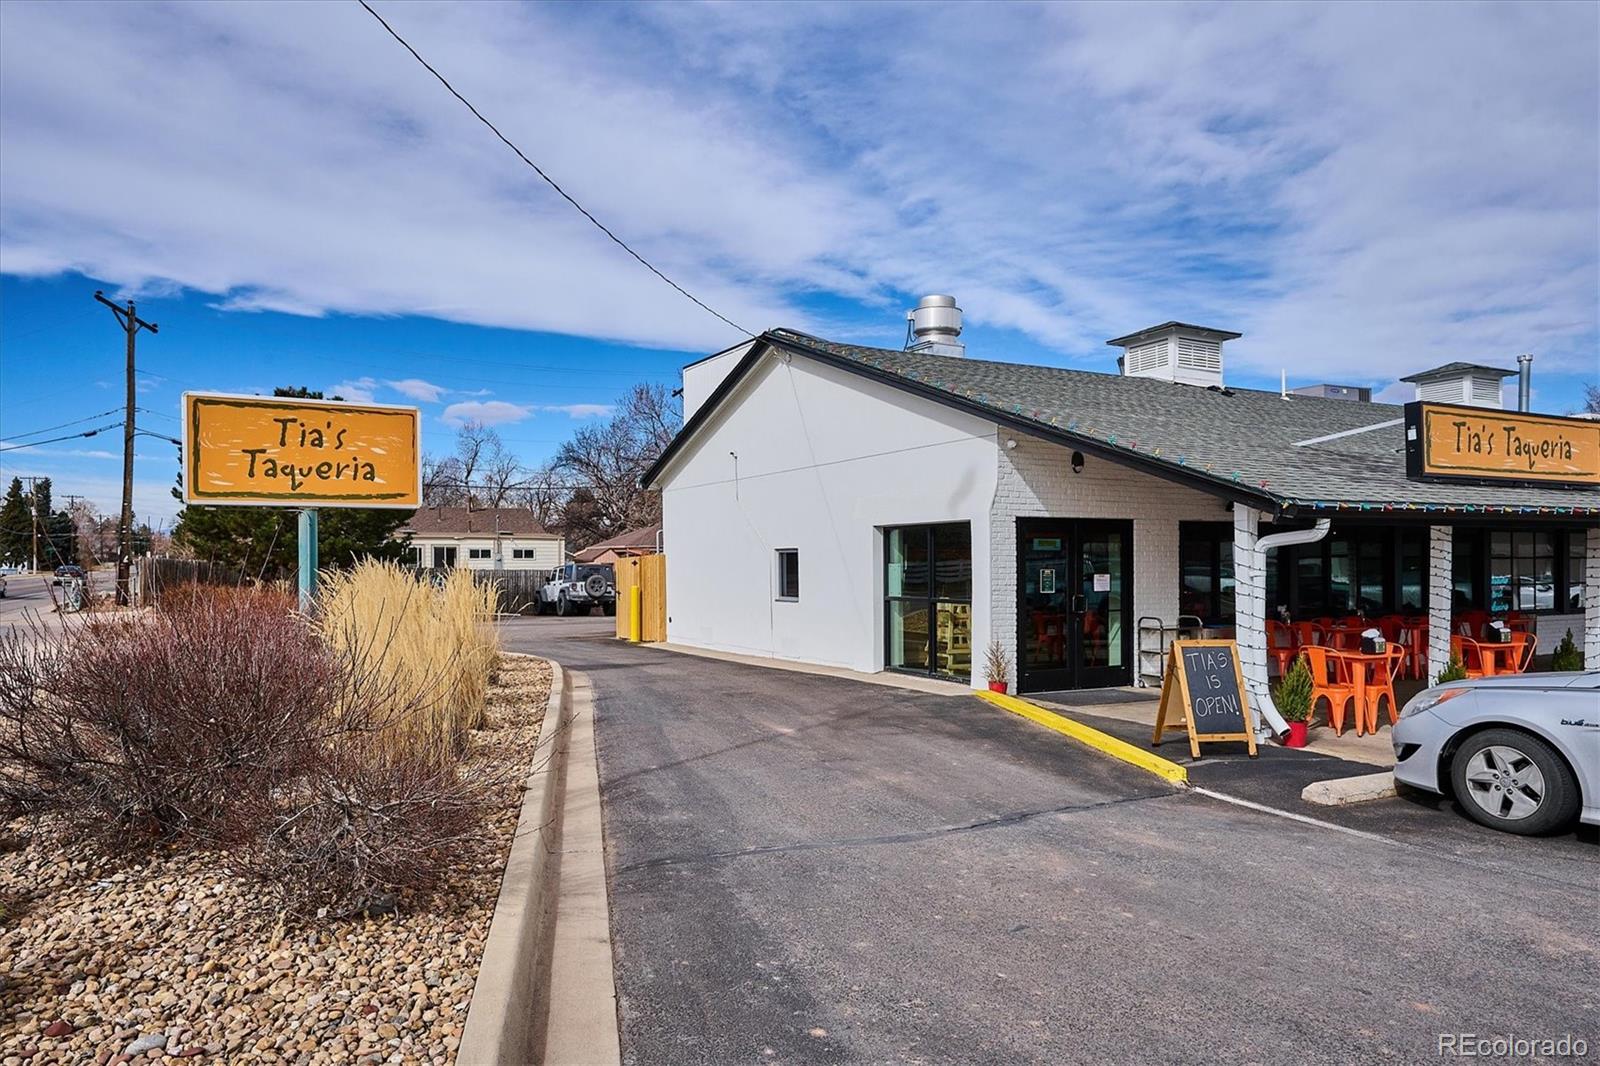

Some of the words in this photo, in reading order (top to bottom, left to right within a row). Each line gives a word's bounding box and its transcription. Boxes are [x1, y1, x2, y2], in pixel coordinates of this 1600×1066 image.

[273, 418, 347, 450] Tia's
[1452, 421, 1495, 455] Tia's
[1503, 426, 1572, 471] Taqueria
[241, 448, 376, 491] Taqueria
[1186, 651, 1228, 672] TIA'S
[1205, 674, 1222, 689] IS
[1195, 694, 1240, 717] OPEN!
